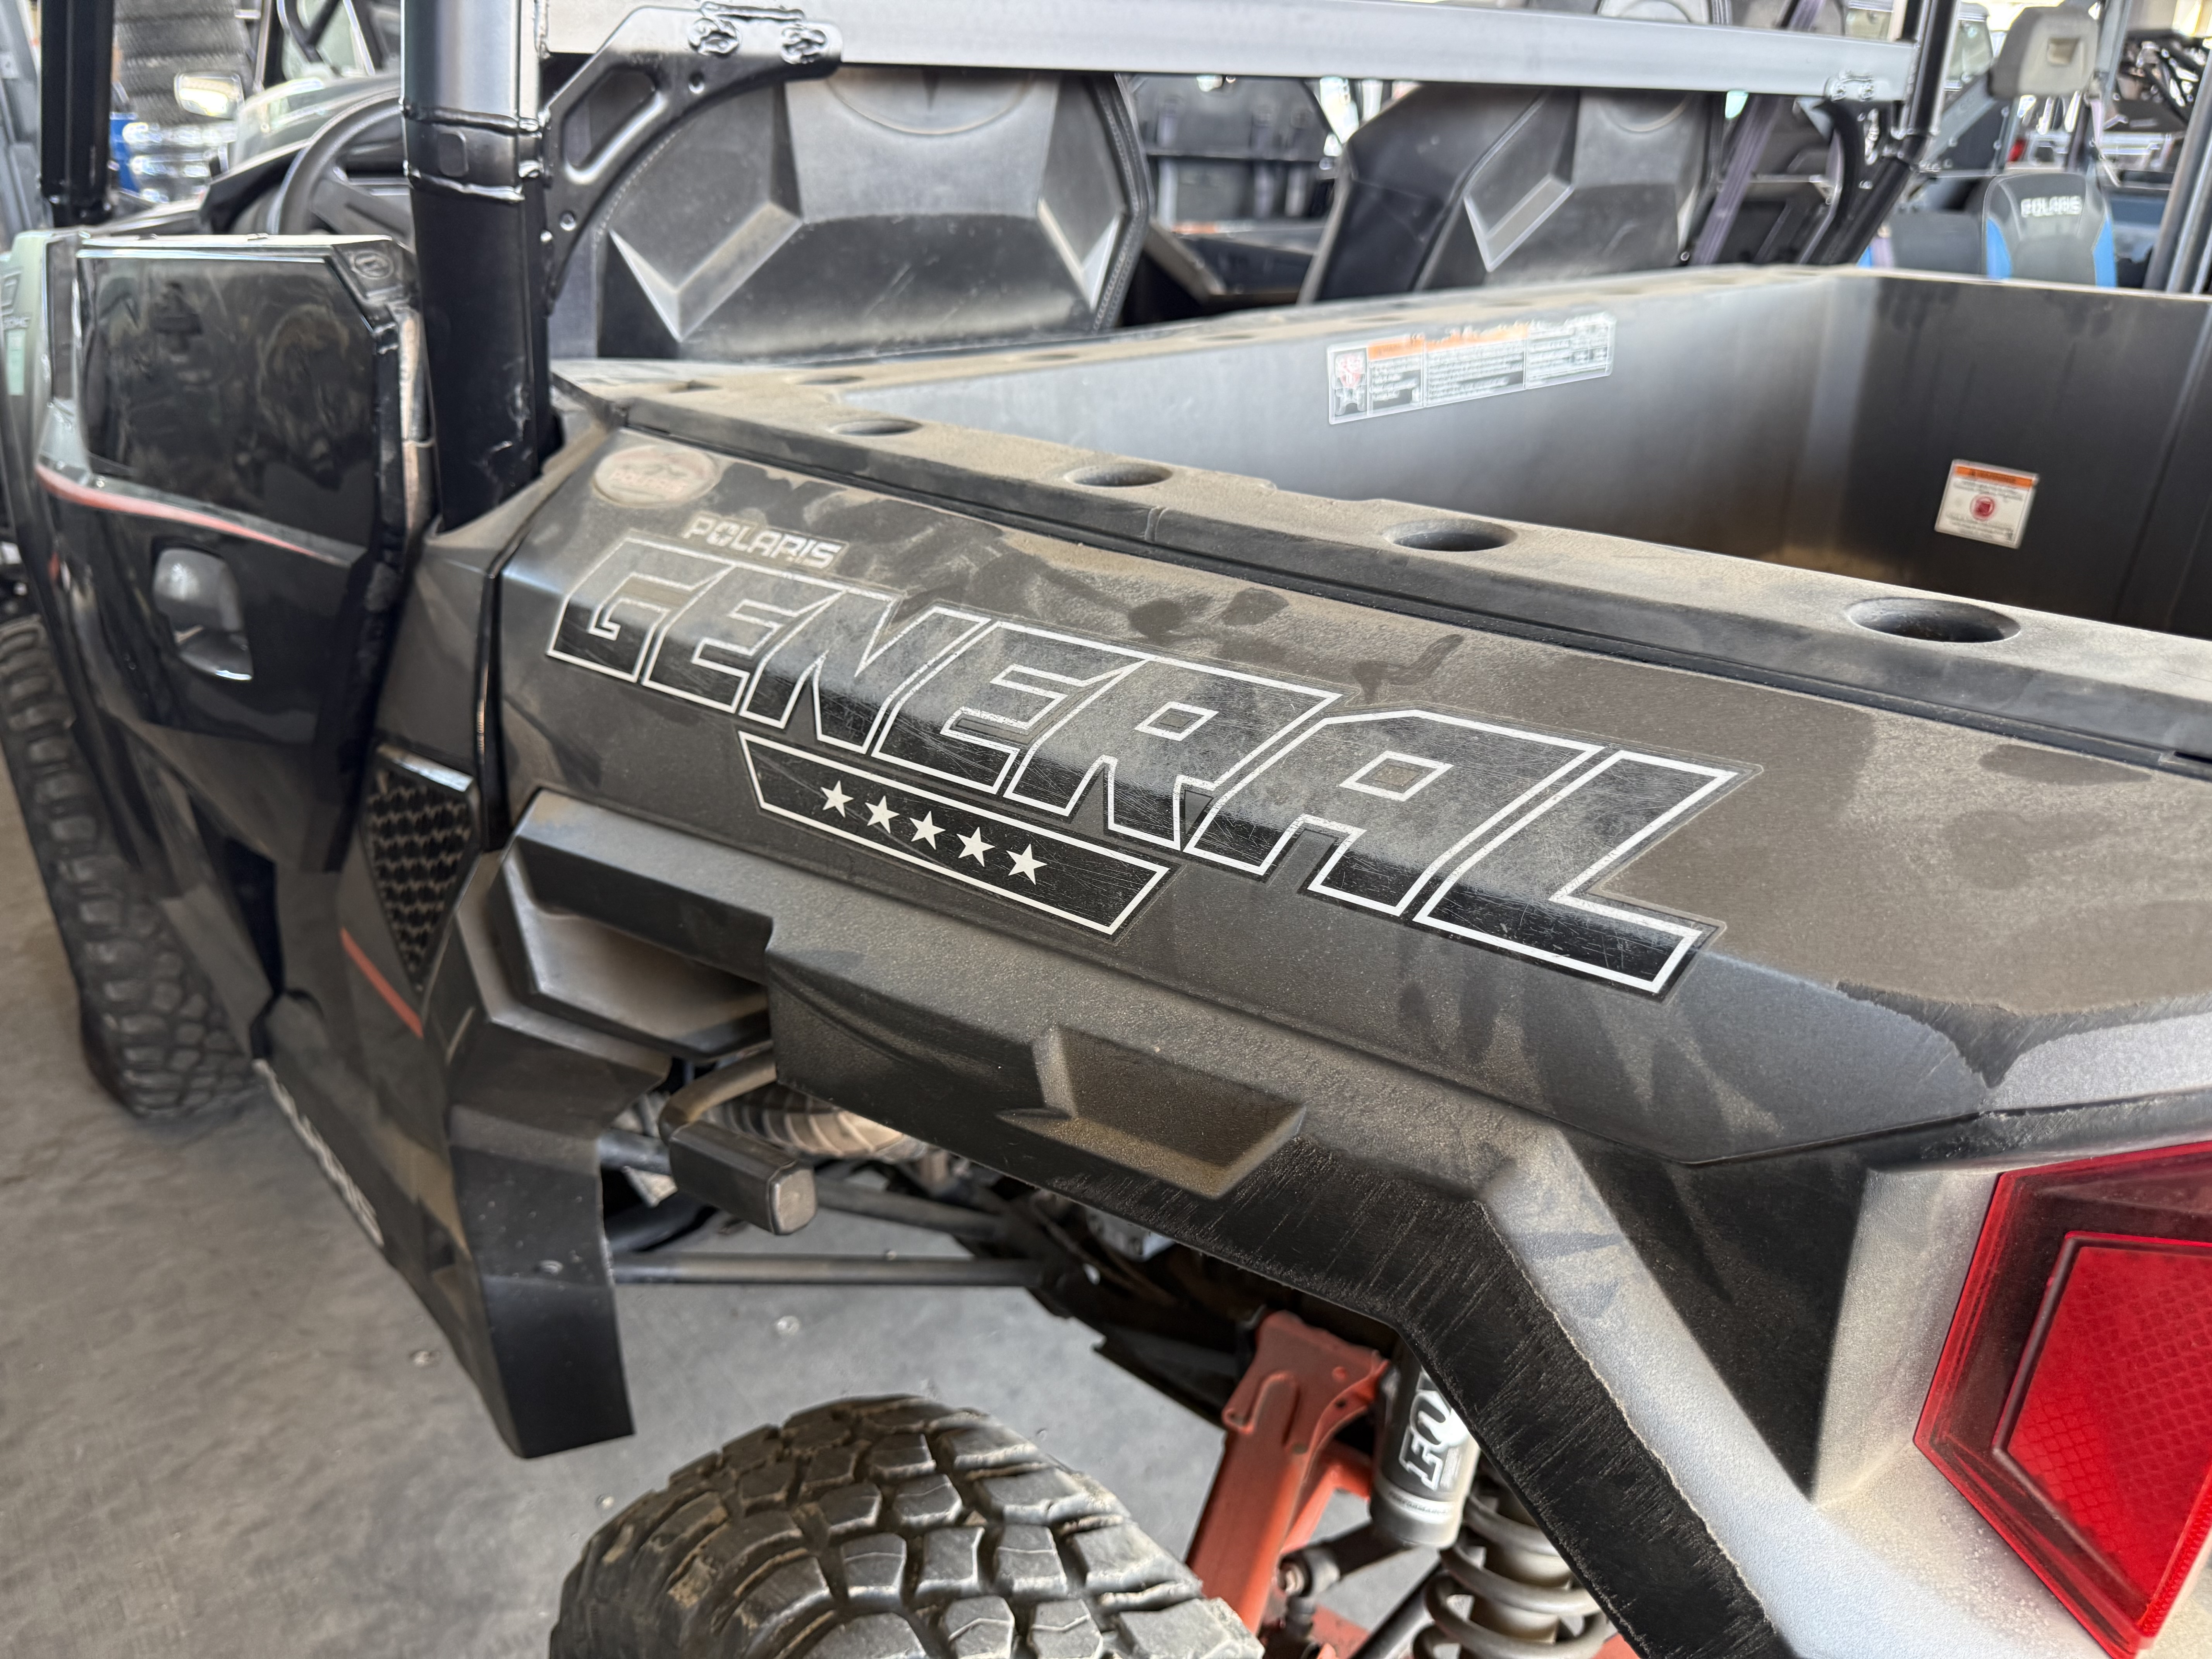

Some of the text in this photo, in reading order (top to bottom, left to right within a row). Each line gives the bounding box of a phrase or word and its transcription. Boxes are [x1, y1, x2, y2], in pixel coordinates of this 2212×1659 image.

[2021, 196, 2083, 218] POLARIS
[682, 514, 843, 568] POLARIS
[547, 538, 1739, 993] GENERAL
